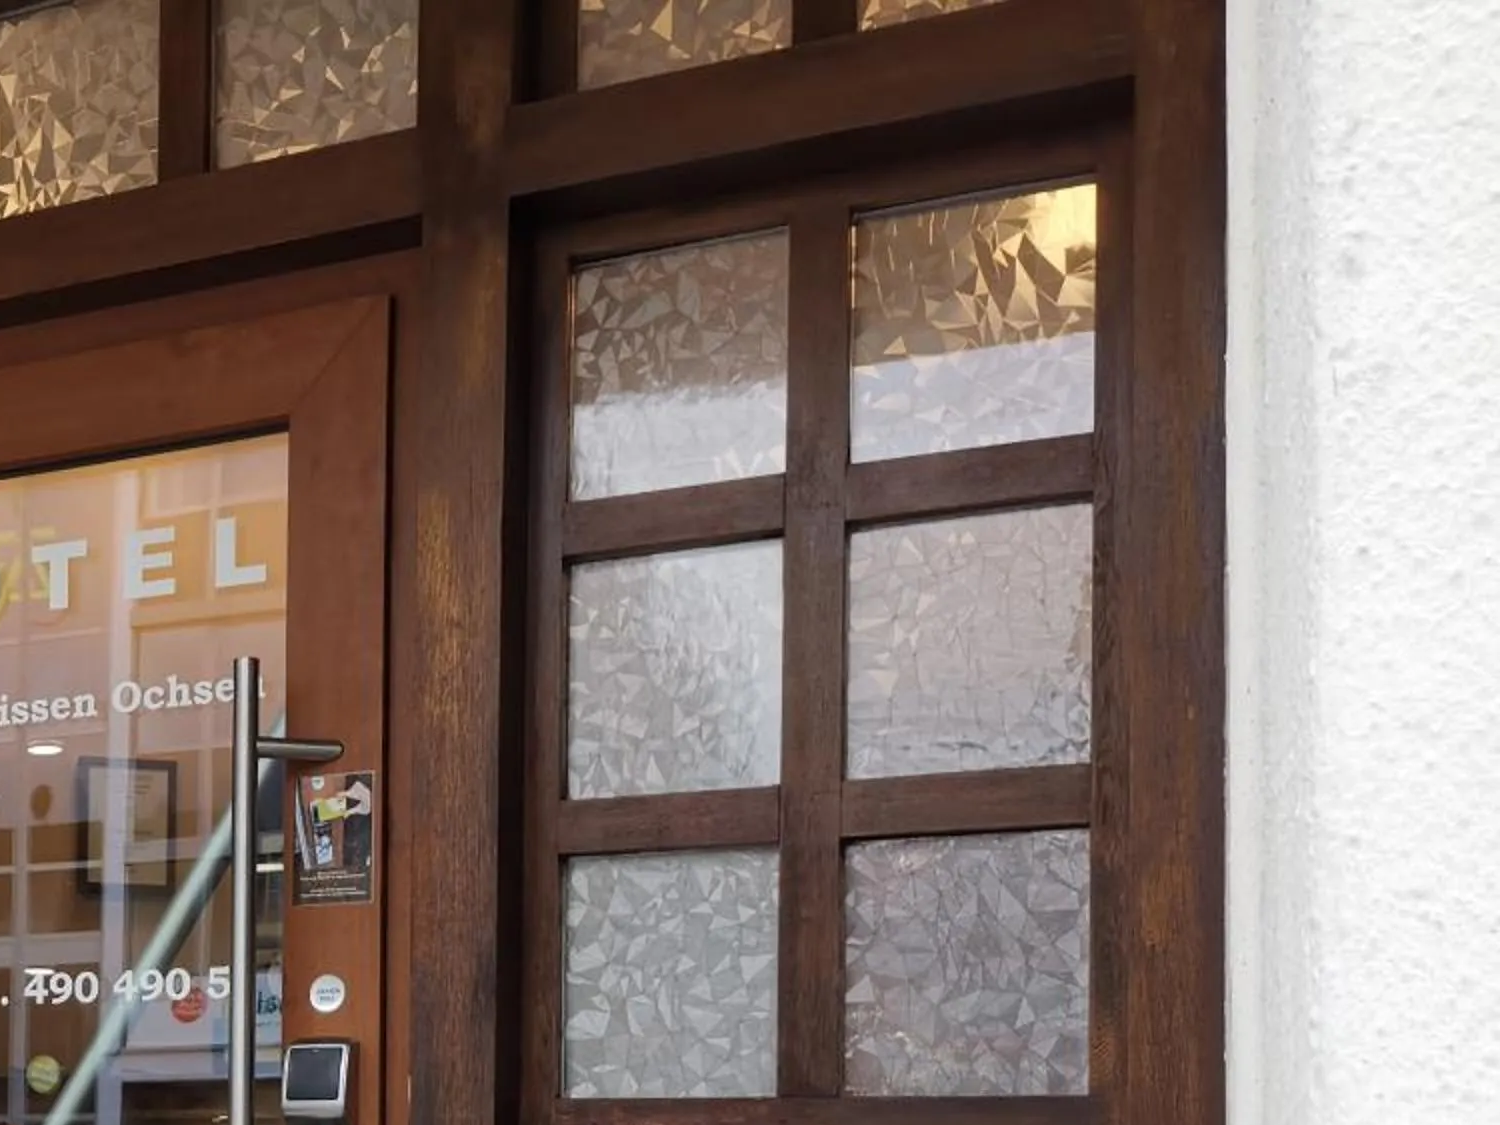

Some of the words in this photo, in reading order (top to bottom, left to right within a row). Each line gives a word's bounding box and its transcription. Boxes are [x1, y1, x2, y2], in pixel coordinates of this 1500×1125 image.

[23, 969, 99, 1005] 490
[113, 967, 191, 1002] 490
[207, 966, 231, 999] 5
